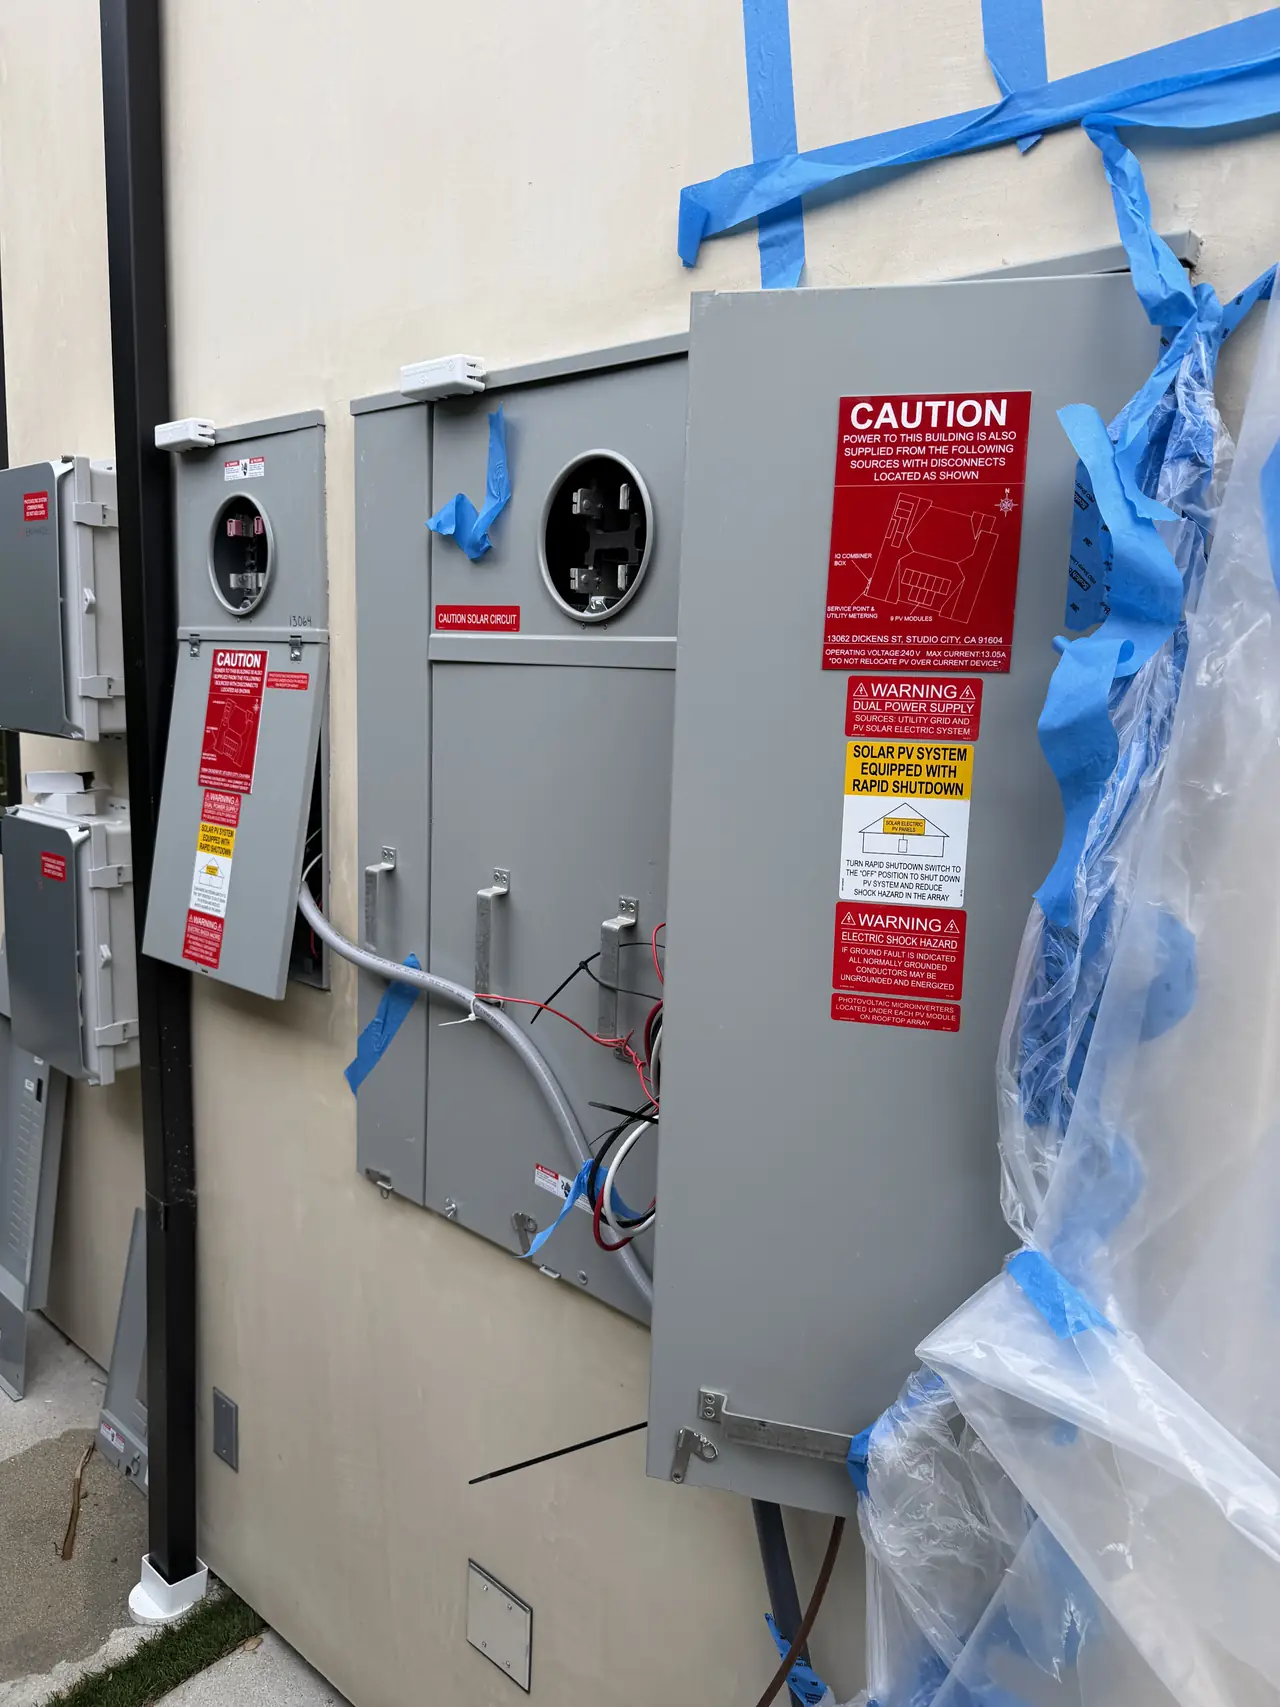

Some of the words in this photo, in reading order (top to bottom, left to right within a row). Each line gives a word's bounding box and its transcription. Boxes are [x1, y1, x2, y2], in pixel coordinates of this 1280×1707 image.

[851, 399, 1007, 429] CAUTION
[843, 435, 880, 443] POWER
[884, 434, 897, 443] TO
[900, 434, 922, 442] THIS
[926, 432, 974, 442] BUILDING
[977, 432, 986, 440] IS
[988, 431, 1016, 440] ALSO
[844, 448, 893, 456] SUPPLIED
[896, 447, 925, 455] FROM
[952, 444, 1014, 454] FOLLOWING
[850, 460, 899, 469] SOURCES
[902, 459, 927, 467] WITH
[931, 458, 1006, 467] DISCONNECTS
[874, 472, 920, 481] LOCATED
[923, 472, 936, 480] AS
[939, 471, 978, 479] SHOWN
[289, 615, 312, 627] 13064
[439, 613, 466, 623] CAUTION
[467, 614, 488, 624] SOLAR
[490, 615, 516, 624] CIRCUIT
[217, 652, 261, 668] CAUTION
[871, 683, 957, 698] WARNING
[853, 701, 882, 711] DUAL
[885, 702, 926, 712] POWER
[930, 704, 974, 713] SUPPLY
[854, 745, 894, 758] SOLAR
[898, 747, 914, 759] PV
[917, 748, 967, 761] SYSTEM
[861, 763, 922, 777] EQUIPPED
[926, 765, 956, 778] WITH
[853, 779, 888, 792] RAPID
[892, 781, 963, 795] SHUTDOWN
[210, 792, 234, 804] WARNING
[220, 827, 234, 837] SYSTEM
[925, 864, 950, 872] SWITCH
[915, 883, 942, 891] REDUCE
[193, 916, 217, 929] WARNING
[858, 913, 941, 932] WARNING
[842, 932, 884, 943] ELECTRIC
[886, 935, 917, 946] SHOCK
[920, 938, 957, 949] HAZARD
[850, 948, 882, 956] GROUND
[917, 952, 956, 962] INDICATED
[863, 957, 902, 966] NORMALLY
[904, 961, 947, 971] GROUNDED
[856, 966, 907, 977] CONDUCTORS
[840, 974, 892, 985] UNGROUNDED
[911, 980, 954, 990] ENERGIZED
[838, 997, 890, 1007] PHOTOVOLTAIC
[892, 1001, 954, 1013] MICROINVERTERS
[872, 1015, 906, 1023] ROOFTOP
[926, 1012, 956, 1021] MODULE
